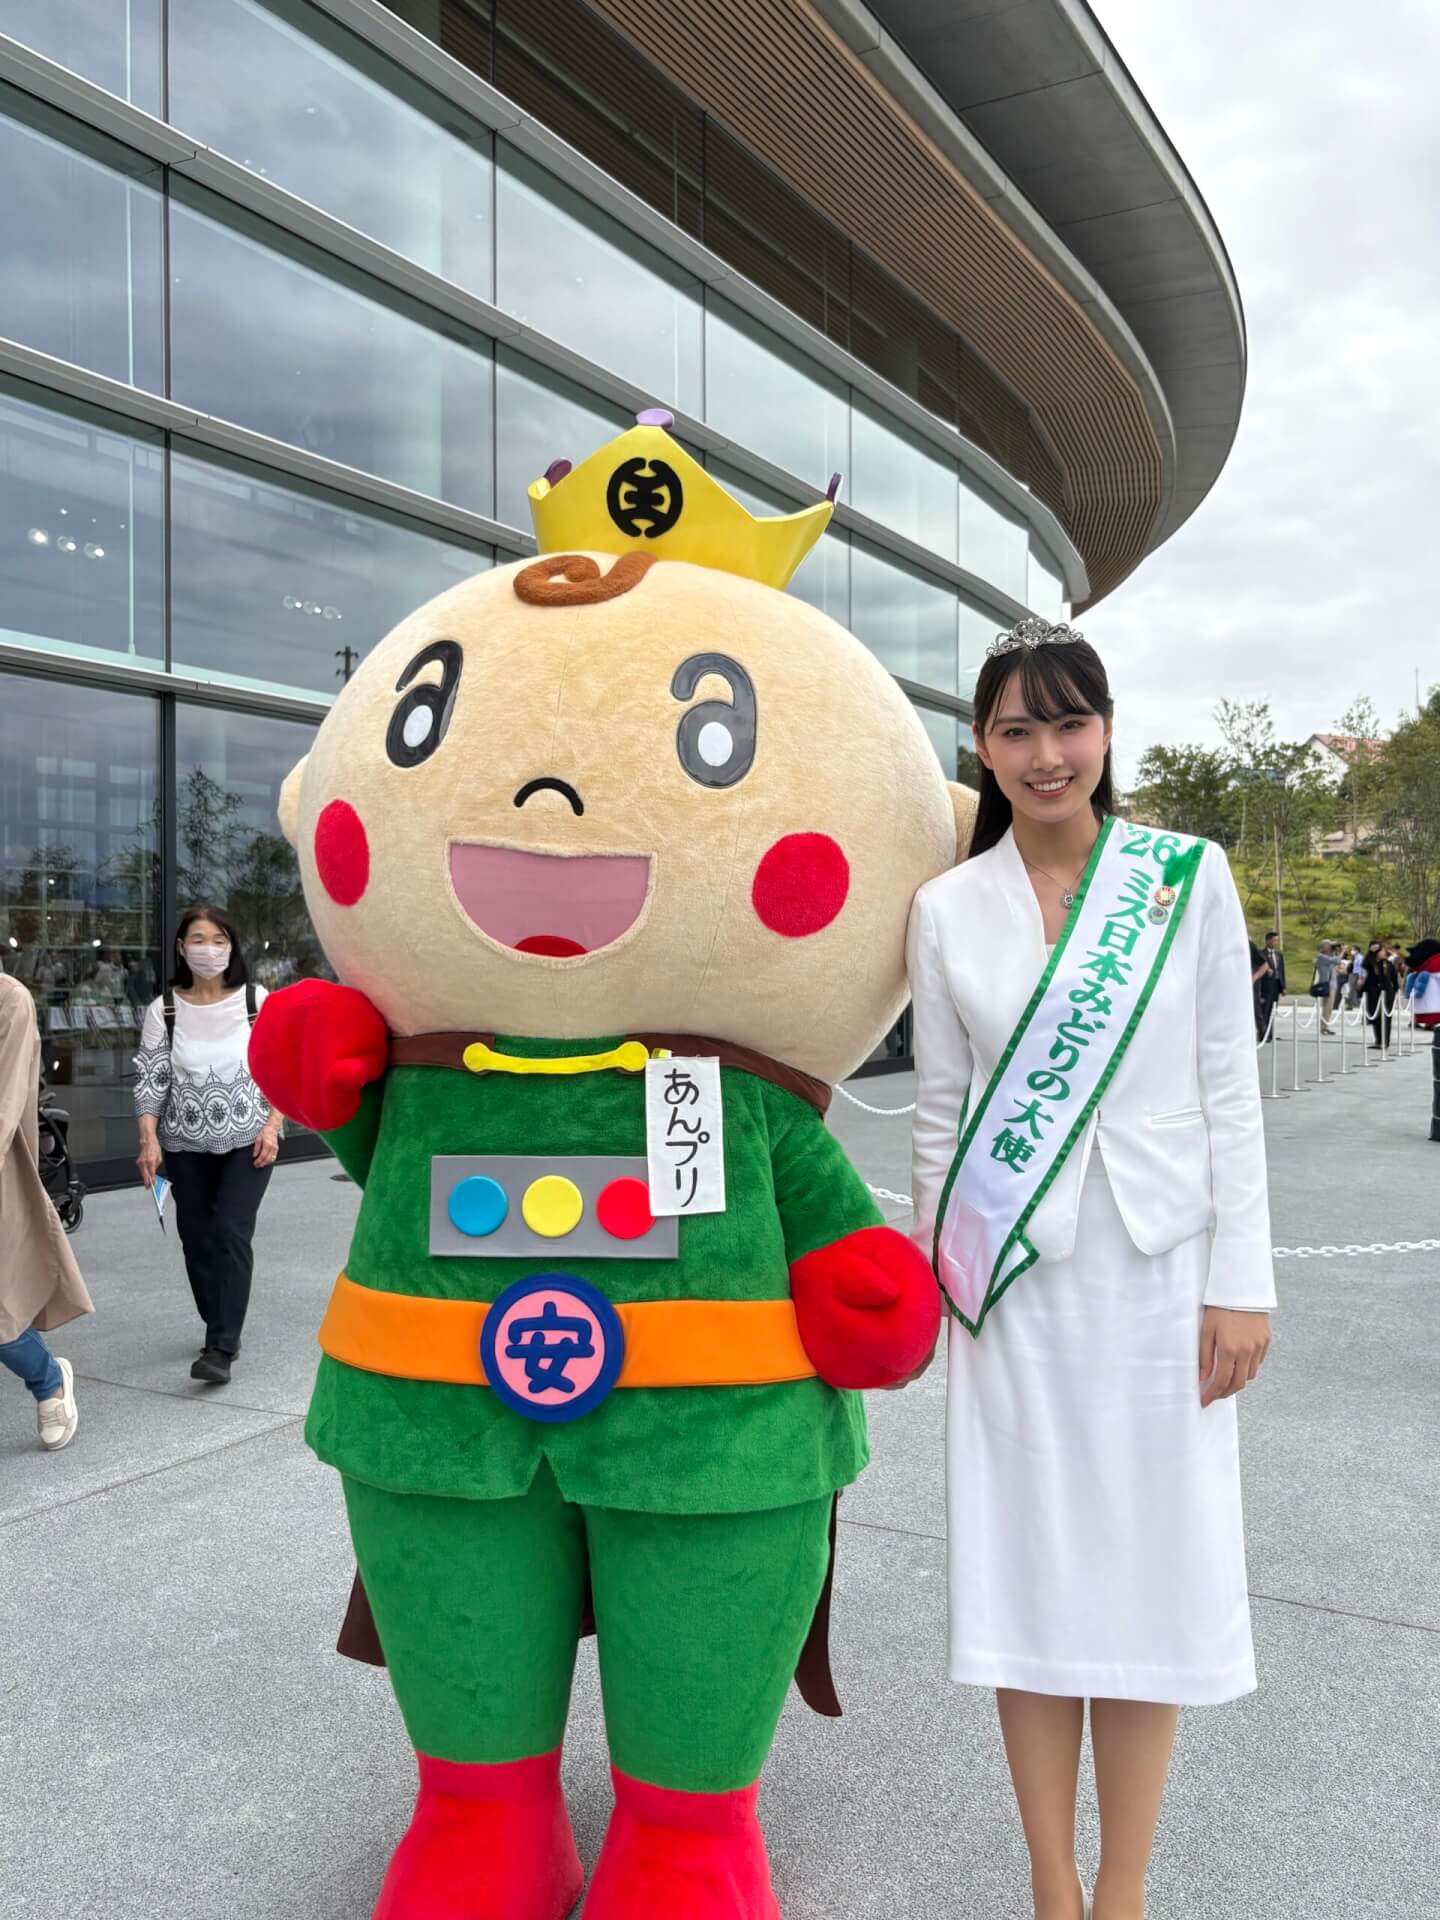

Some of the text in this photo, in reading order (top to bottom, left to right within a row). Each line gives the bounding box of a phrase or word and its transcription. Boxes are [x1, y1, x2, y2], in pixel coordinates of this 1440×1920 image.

[990, 867, 1155, 1174] ミス日本みどりの大使
[664, 1068, 710, 1207] あんプリ
[505, 1301, 595, 1393] 安
